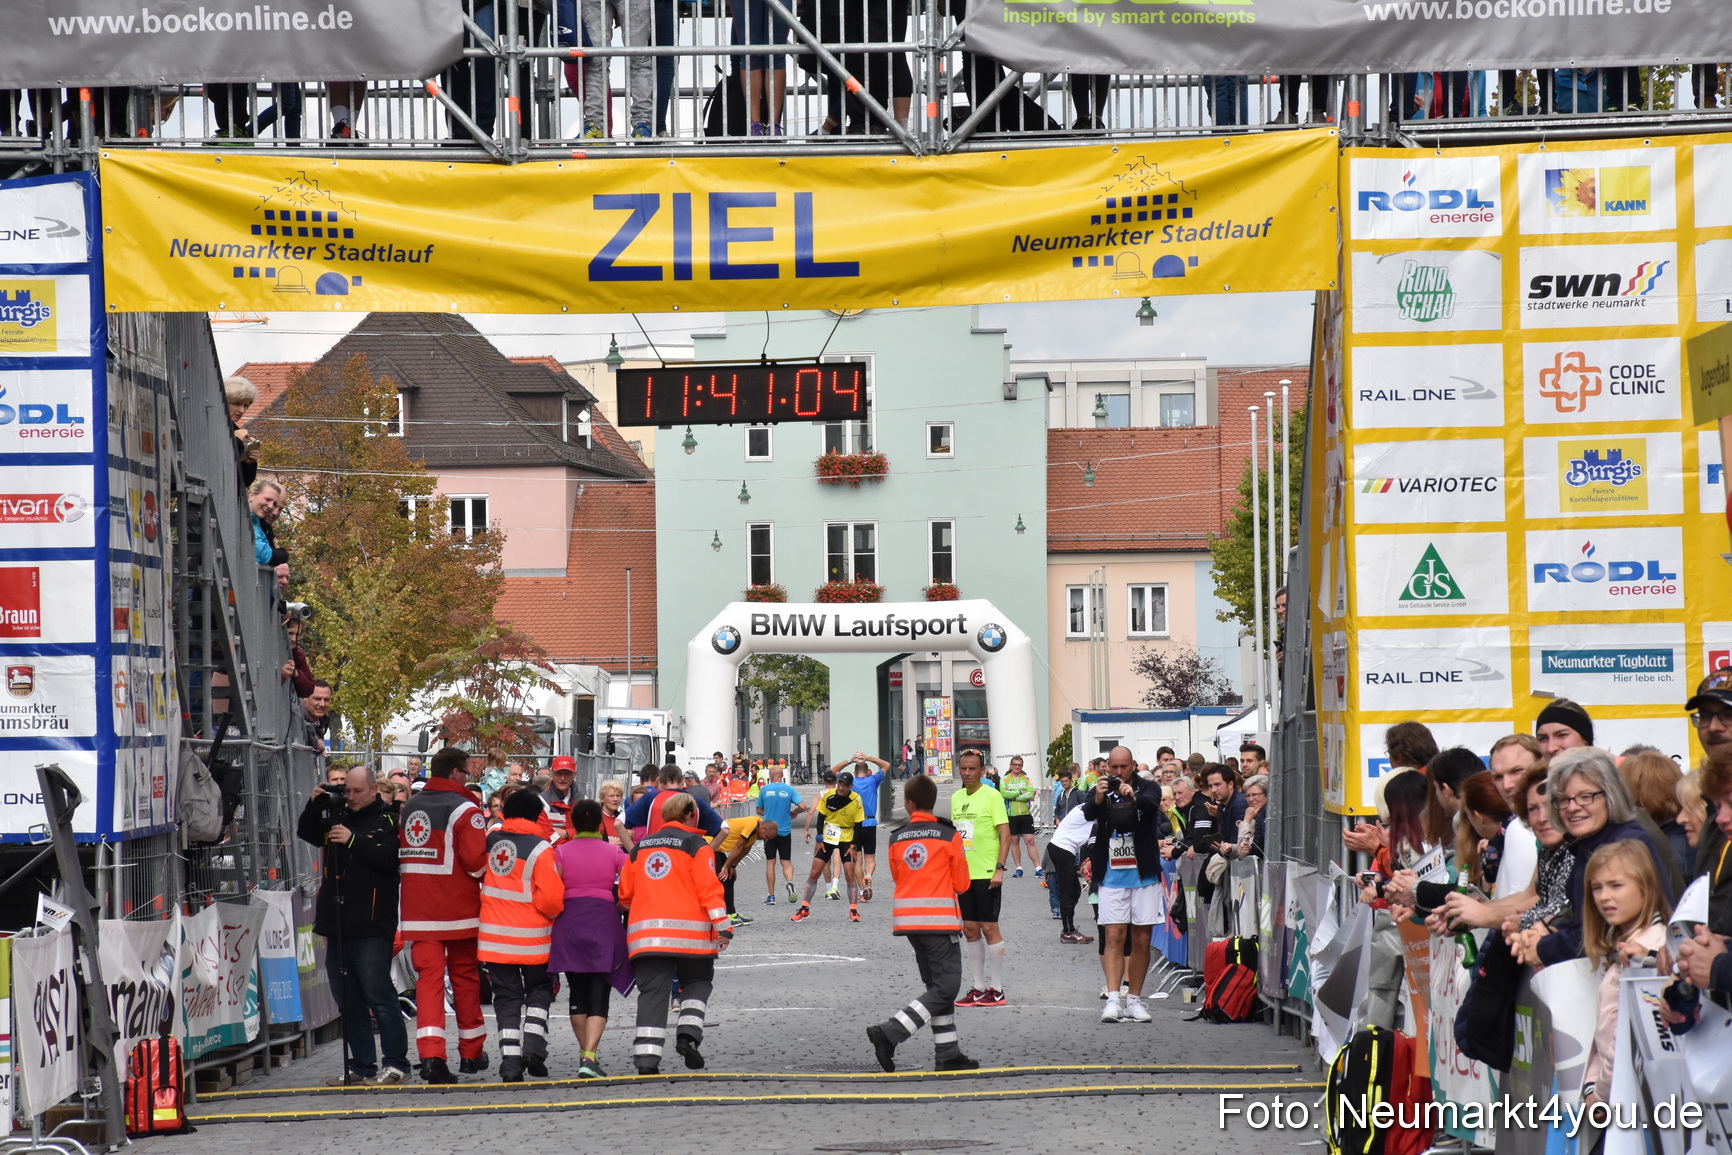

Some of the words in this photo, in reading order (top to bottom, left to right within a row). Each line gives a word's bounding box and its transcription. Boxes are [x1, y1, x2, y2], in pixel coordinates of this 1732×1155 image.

[1003, 7, 1079, 27] inspired
[1083, 8, 1106, 27] by
[1110, 8, 1165, 25] smart
[1171, 9, 1256, 26] concepts
[1362, 0, 1671, 21] www.bockonline.de
[48, 4, 353, 36] www.bockonline.de
[1604, 199, 1647, 212] KANN
[1429, 206, 1495, 224] energie
[588, 191, 860, 282] ZIEL
[1011, 227, 1154, 253] Neumarkter
[1160, 217, 1274, 244] Stadtlauf
[169, 237, 316, 261] Neumarkter
[323, 242, 435, 265] Stadtlauf
[1399, 259, 1450, 293] RUND
[1527, 271, 1624, 299] swn
[1398, 292, 1458, 320] SCHAU
[1526, 298, 1589, 311] stadtwerke
[1591, 297, 1646, 310] neumarkt
[1, 328, 24, 336] Feinste
[1609, 363, 1656, 379] CODE
[1359, 388, 1456, 402] RAIL.ONE
[1609, 379, 1665, 396] CLINIC
[19, 421, 85, 438] energie
[1565, 460, 1642, 487] Burgis
[1399, 476, 1498, 493] VARIOTEC
[1592, 487, 1615, 495] Feinste
[0, 498, 49, 515] ivari
[1569, 494, 1639, 504] Kartoffelspezialitäten
[1608, 577, 1677, 596] energie
[750, 612, 827, 637] BMW
[834, 613, 968, 640] Laufsport
[1547, 654, 1615, 669] Neumarkter
[1617, 654, 1668, 670] Tagblatt
[1366, 670, 1463, 685] RAIL.ONE
[1613, 674, 1633, 683] Hier
[1635, 674, 1654, 683] lebe
[1656, 672, 1675, 682] ich.
[638, 836, 684, 848] BEREITSCHAFTEN
[896, 829, 942, 841] BEREITSCHAFTEN
[1113, 846, 1136, 857] 8003
[1415, 862, 1433, 878] wn
[43, 905, 56, 916] wn
